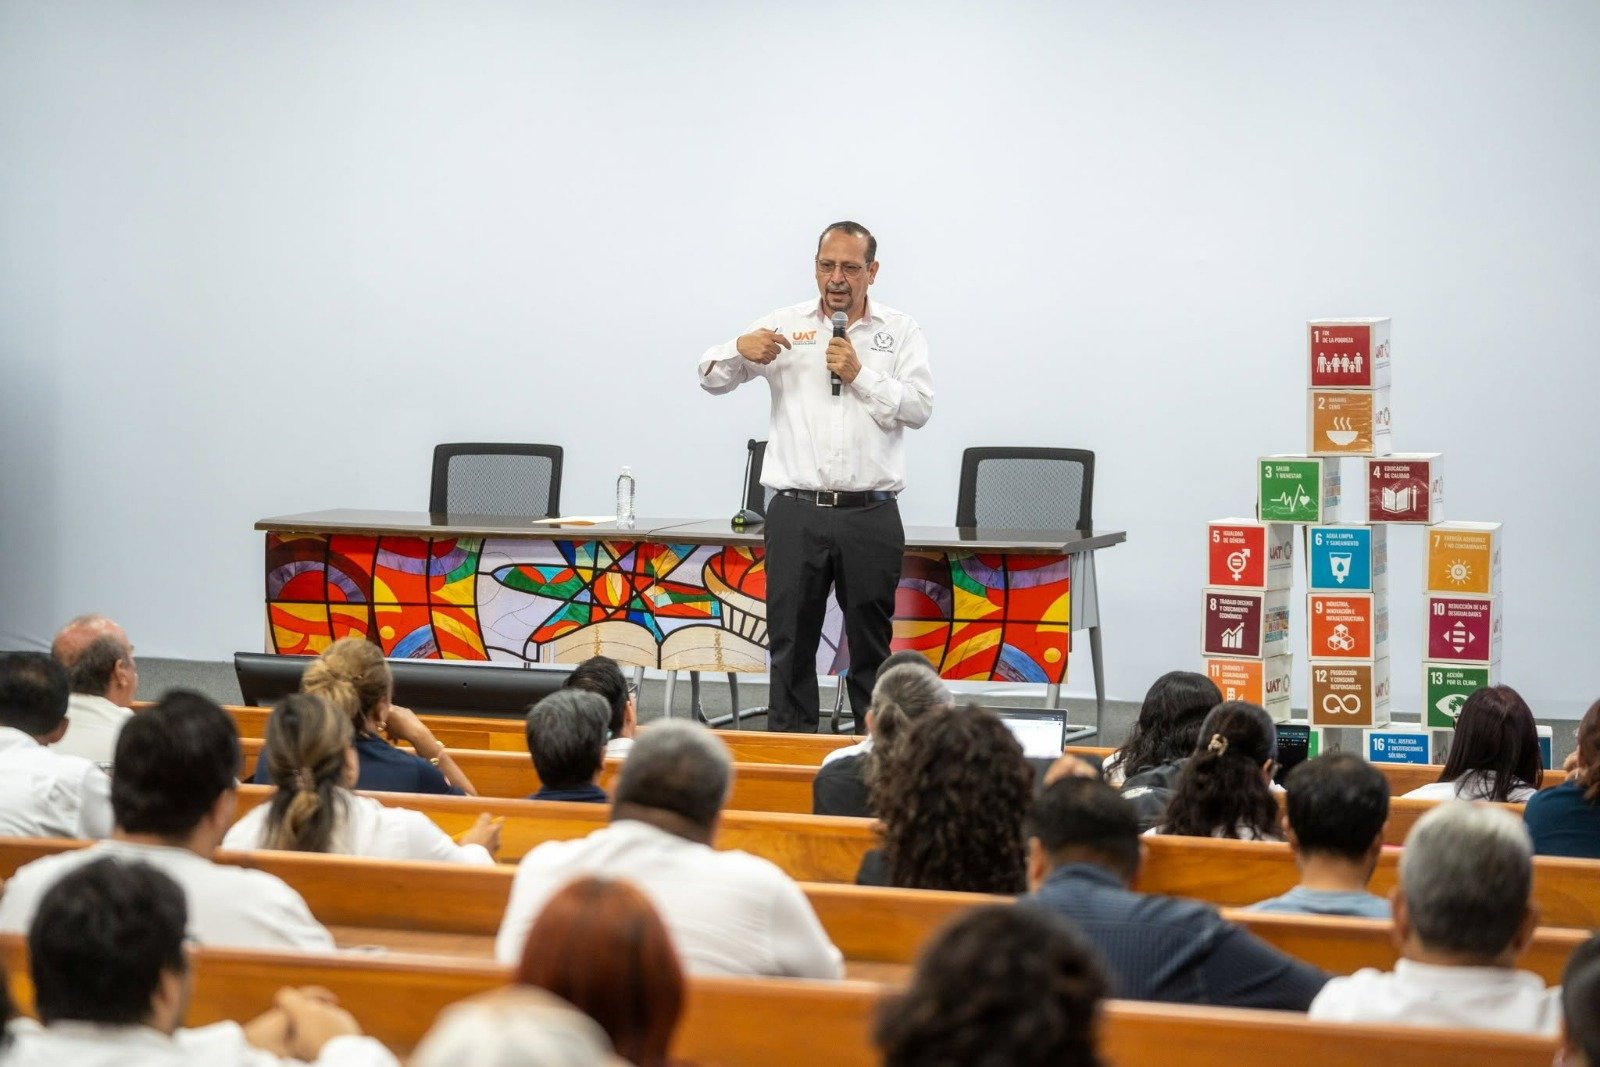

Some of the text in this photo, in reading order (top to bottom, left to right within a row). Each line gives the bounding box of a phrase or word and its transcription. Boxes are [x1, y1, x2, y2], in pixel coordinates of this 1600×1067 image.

[792, 330, 816, 340] UAT
[1314, 330, 1319, 343] 1
[1318, 397, 1325, 410] 2
[1265, 466, 1272, 478] 3
[1373, 466, 1380, 478] 4
[1213, 530, 1220, 543] 5
[1315, 533, 1322, 545] 6
[1434, 535, 1440, 548] 7
[1270, 546, 1282, 560] UAT
[1210, 598, 1217, 611] 8
[1315, 601, 1322, 614] 9
[1432, 603, 1445, 616] 10
[1210, 664, 1220, 677] 11
[1315, 670, 1327, 682] 12
[1430, 672, 1443, 685] 13
[1266, 678, 1281, 694] UAT
[1373, 738, 1385, 751] 16
